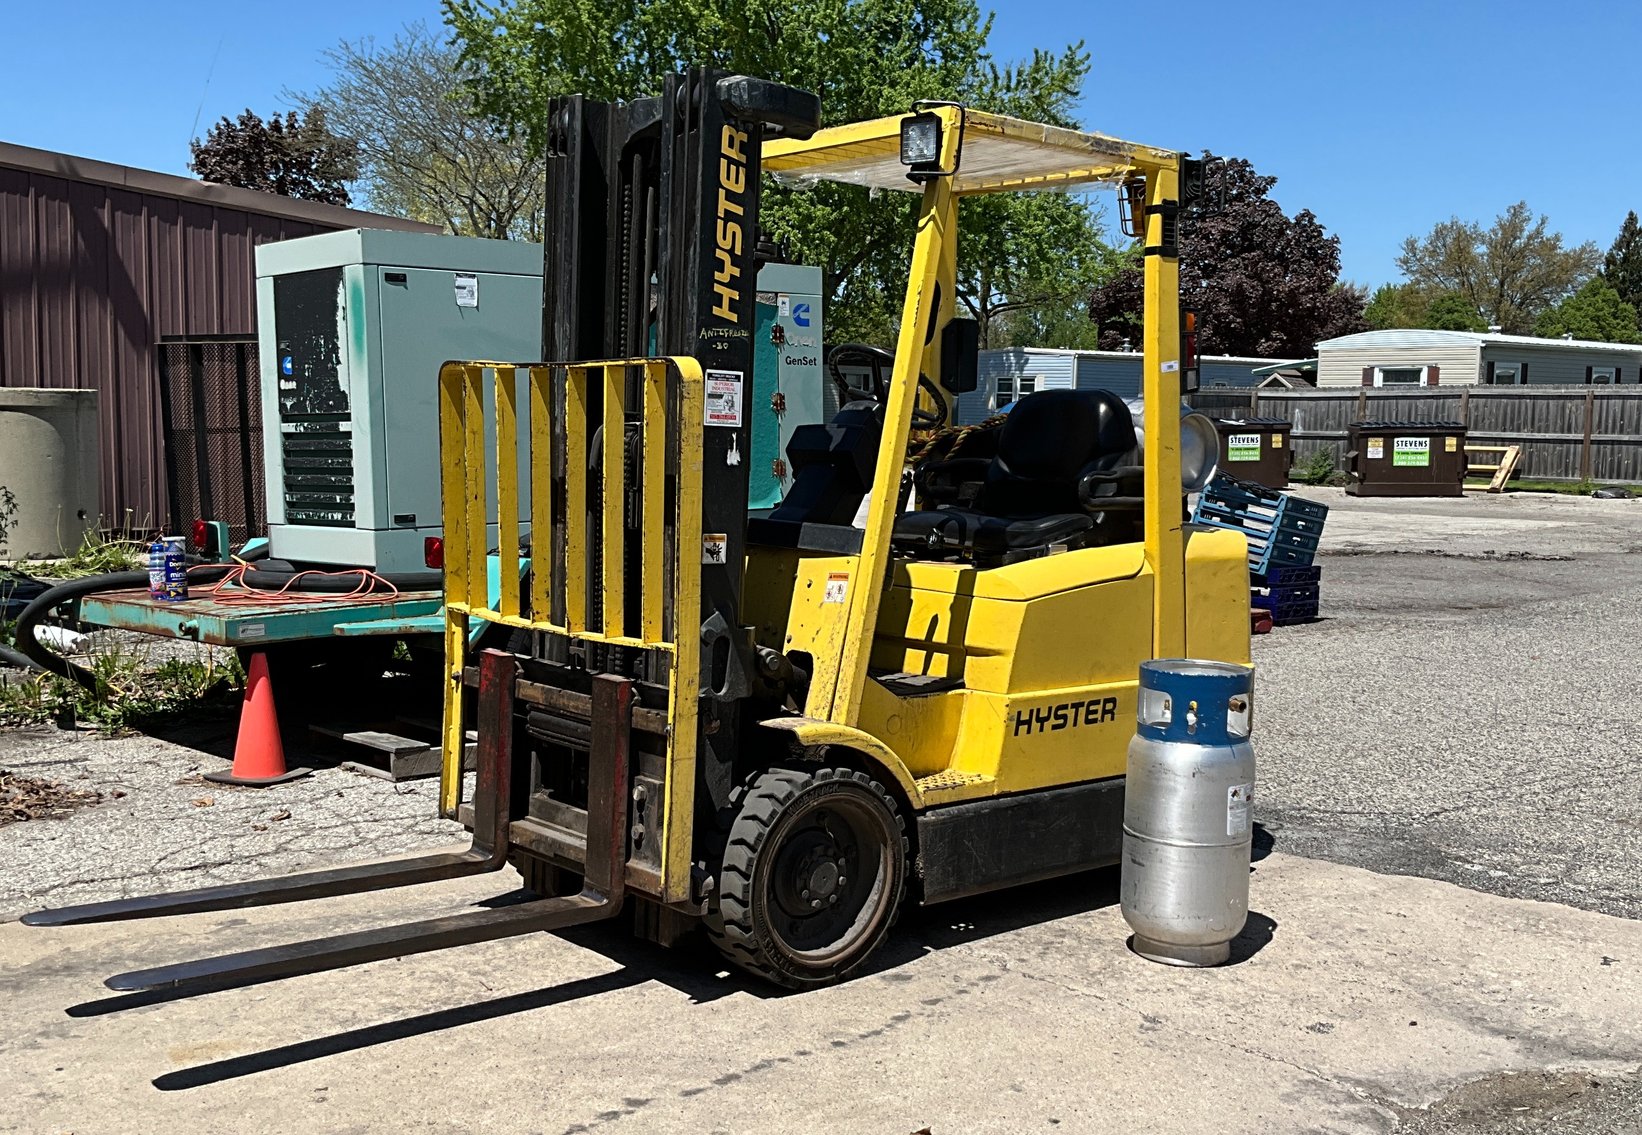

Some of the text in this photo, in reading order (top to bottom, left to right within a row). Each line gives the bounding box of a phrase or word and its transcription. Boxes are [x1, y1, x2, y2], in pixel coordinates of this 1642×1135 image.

[712, 124, 748, 323] HYSTER
[785, 355, 817, 367] GenSet
[1230, 436, 1259, 444] STEVENS
[1396, 440, 1428, 448] STEVENS
[1013, 696, 1118, 737] HYSTER
